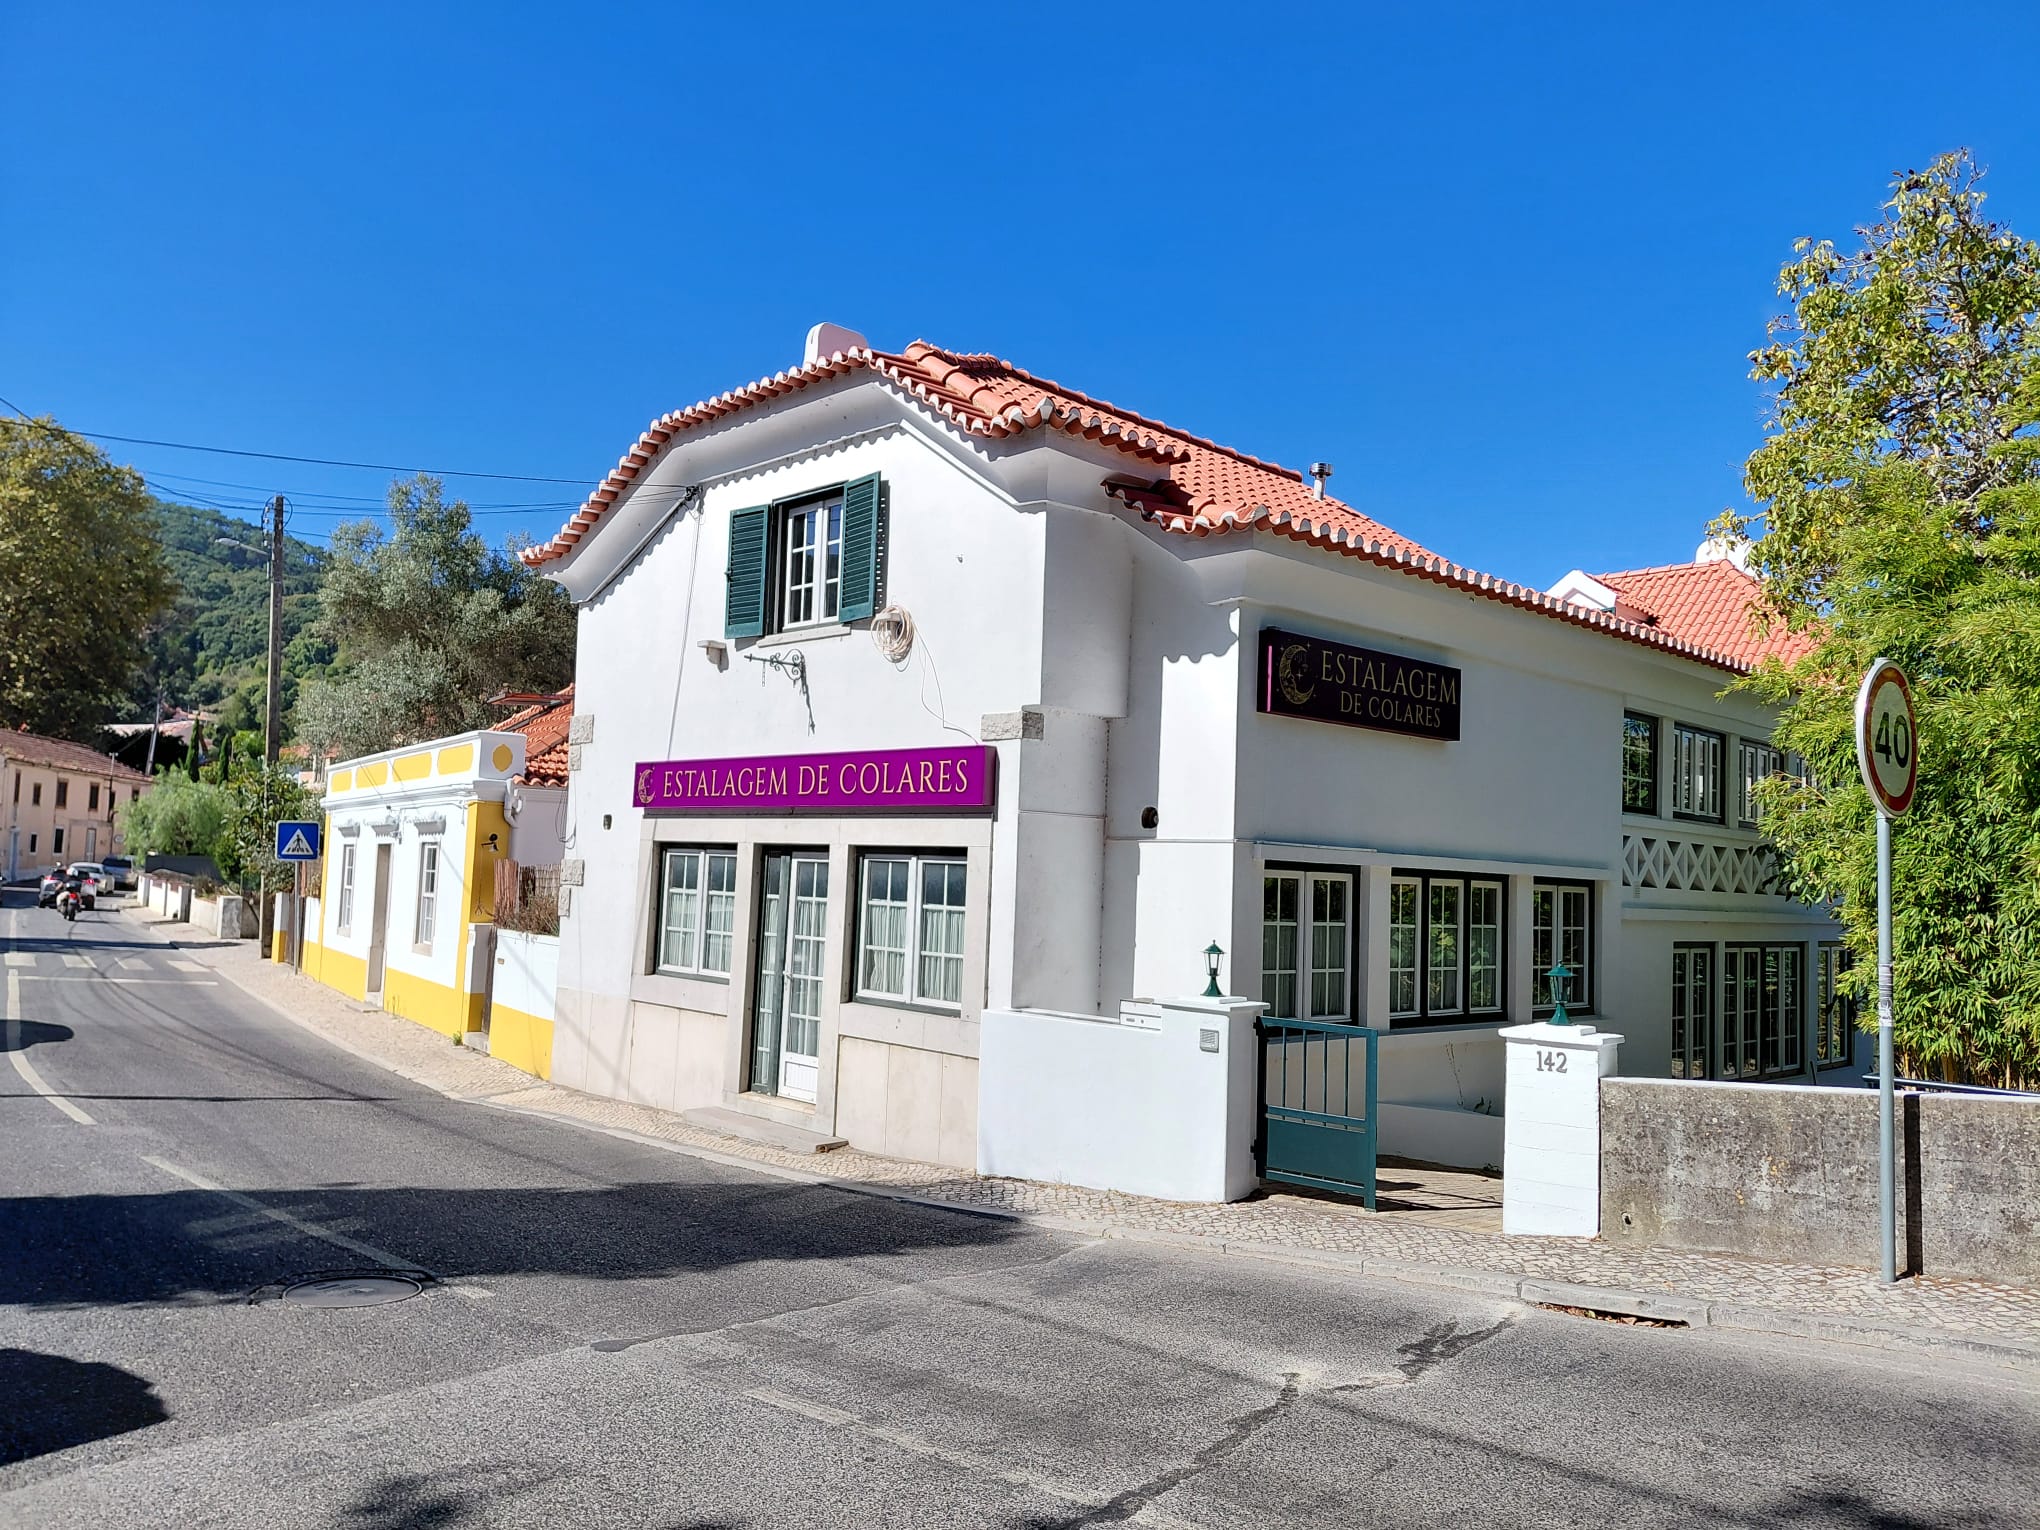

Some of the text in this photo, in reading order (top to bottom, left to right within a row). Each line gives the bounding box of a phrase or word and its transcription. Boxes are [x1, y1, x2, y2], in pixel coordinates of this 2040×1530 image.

[1321, 650, 1457, 705] ESTALAGEM
[1340, 690, 1441, 729] DE COLARES
[1875, 711, 1910, 769] 40
[662, 759, 968, 798] ESTALAGEM DE COLARES
[1536, 1050, 1568, 1074] 142
